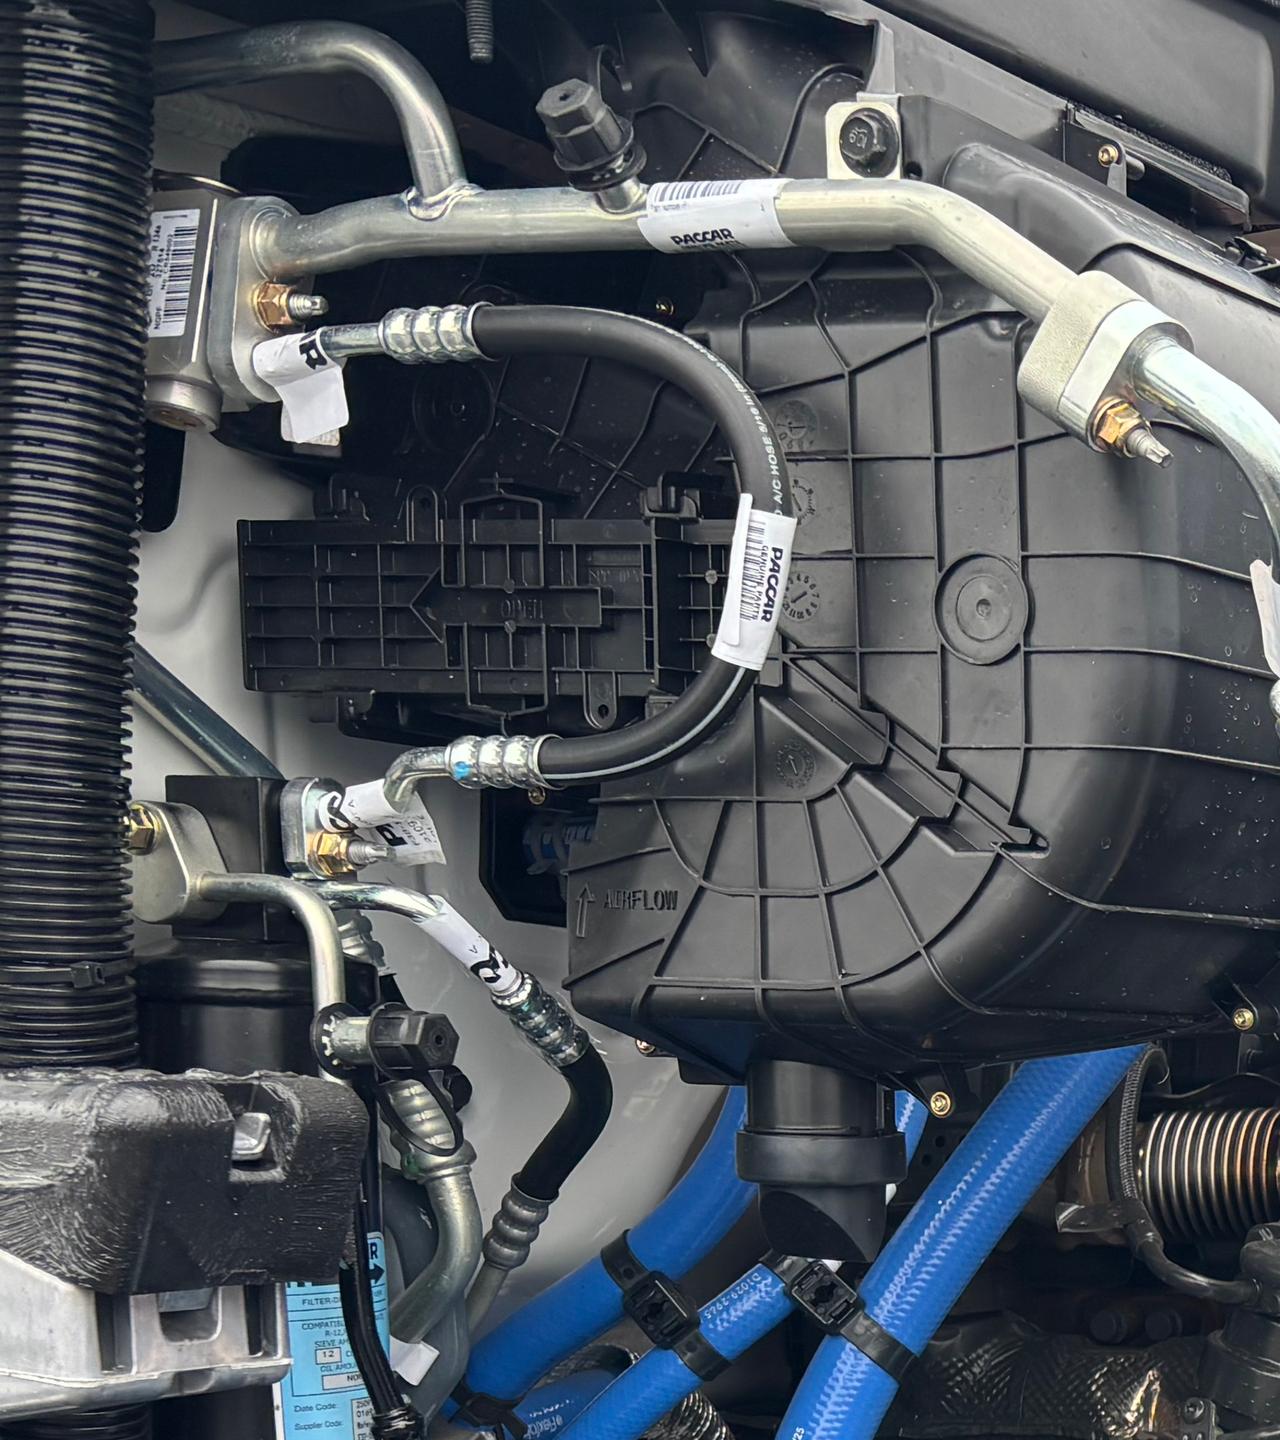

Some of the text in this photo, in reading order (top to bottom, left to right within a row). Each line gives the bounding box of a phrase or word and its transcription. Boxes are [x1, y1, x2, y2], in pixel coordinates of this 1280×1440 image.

[670, 228, 734, 245] PACCAR
[761, 436, 779, 476] HOSE
[761, 547, 784, 623] PACCAR
[603, 889, 679, 911] AIRFLOW
[322, 1350, 335, 1358] 12
[294, 1404, 314, 1413] Date
[294, 1422, 323, 1431] Supplier
